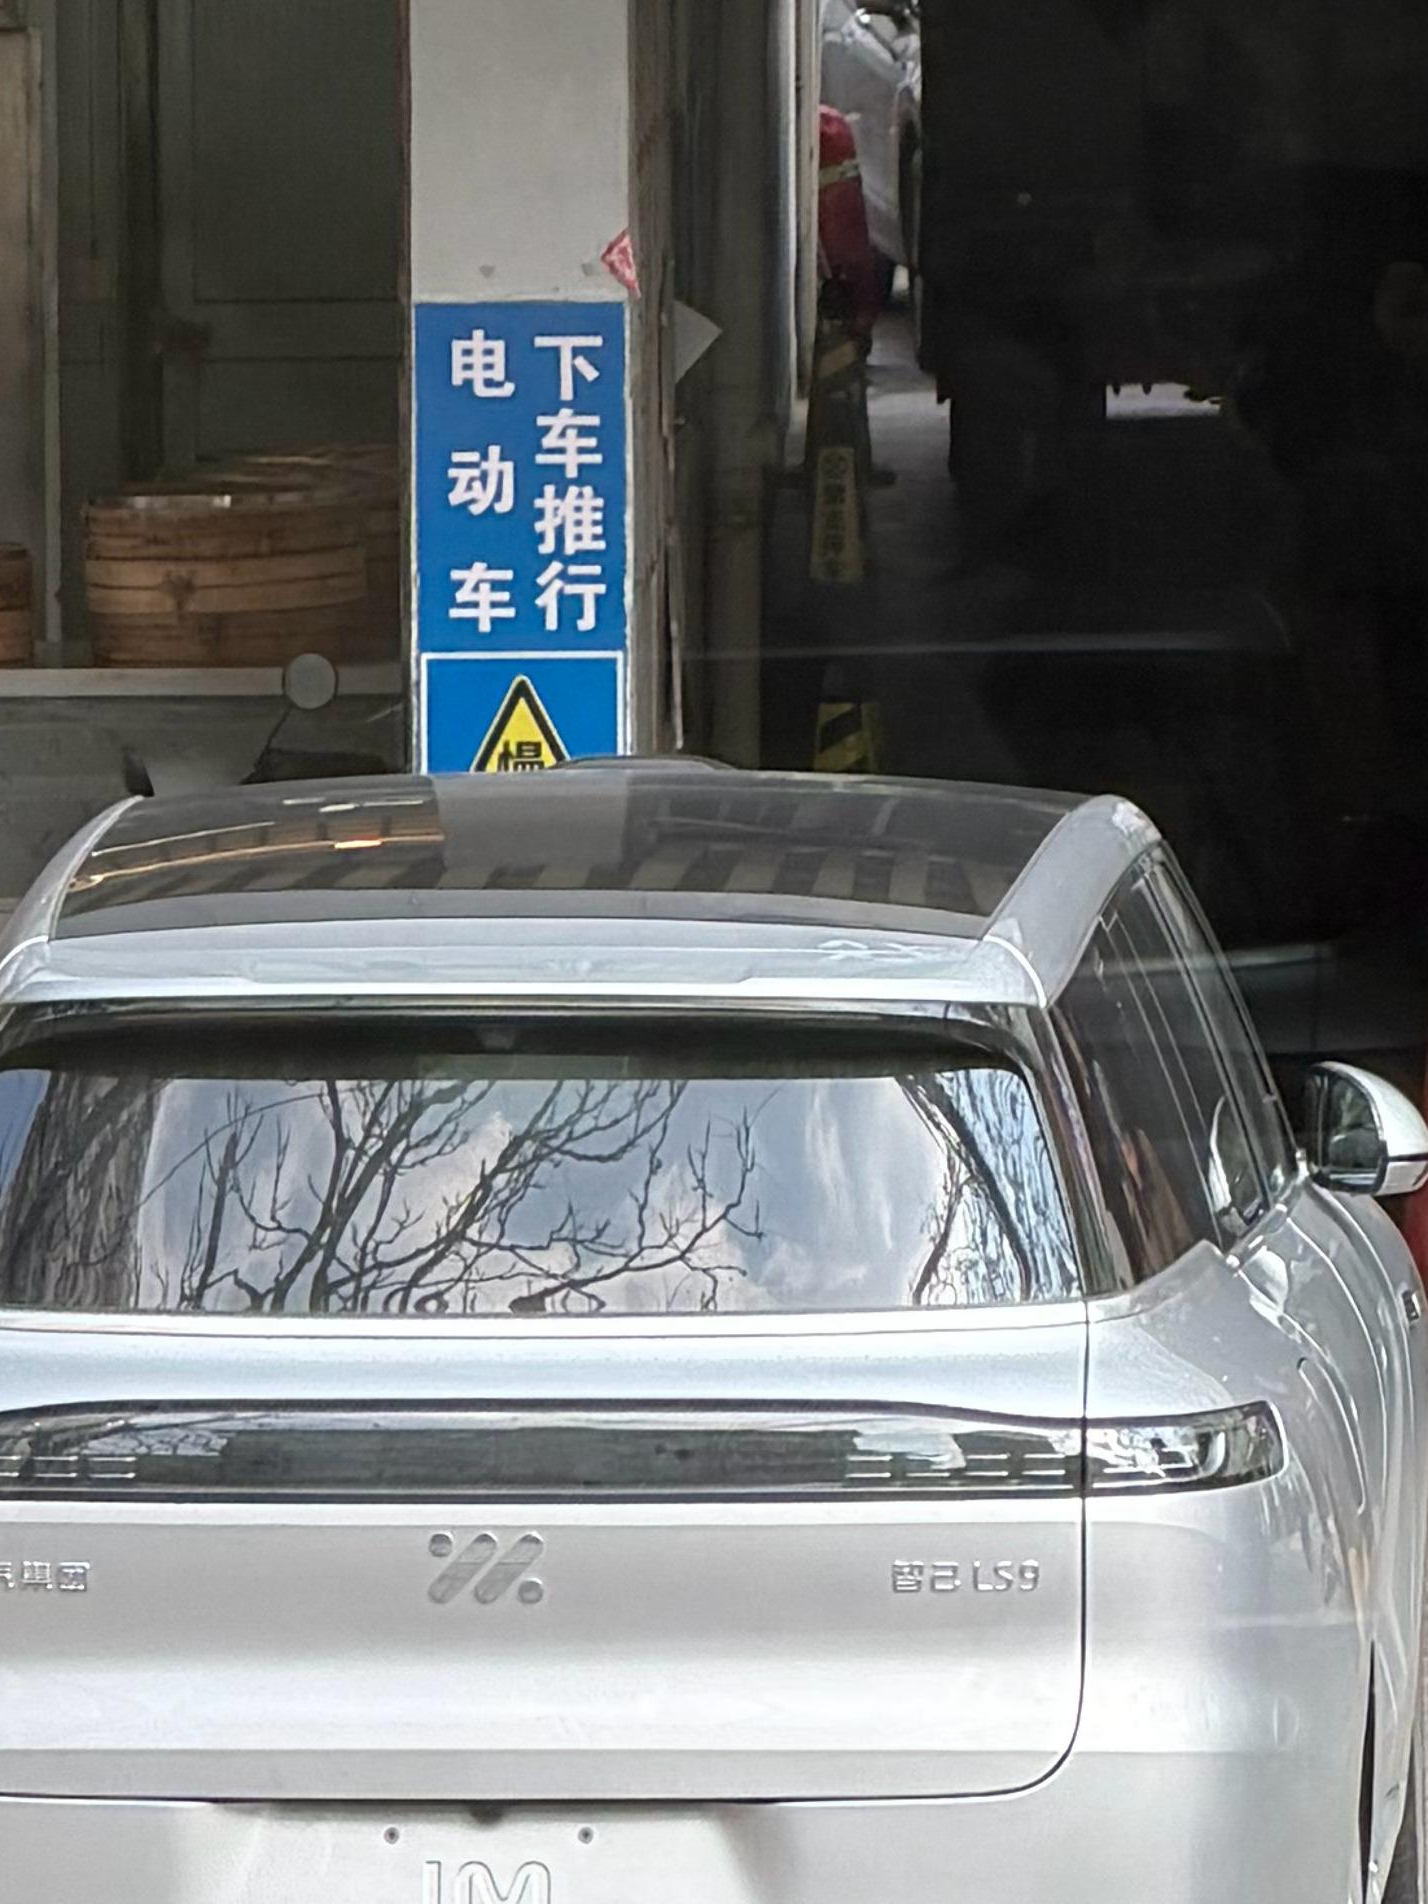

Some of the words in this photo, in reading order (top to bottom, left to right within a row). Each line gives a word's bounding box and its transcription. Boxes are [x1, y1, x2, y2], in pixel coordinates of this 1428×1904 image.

[448, 329, 516, 632] 电动车
[533, 335, 607, 632] 下车推行
[892, 1560, 962, 1593] 智己
[971, 1560, 1040, 1592] LS9
